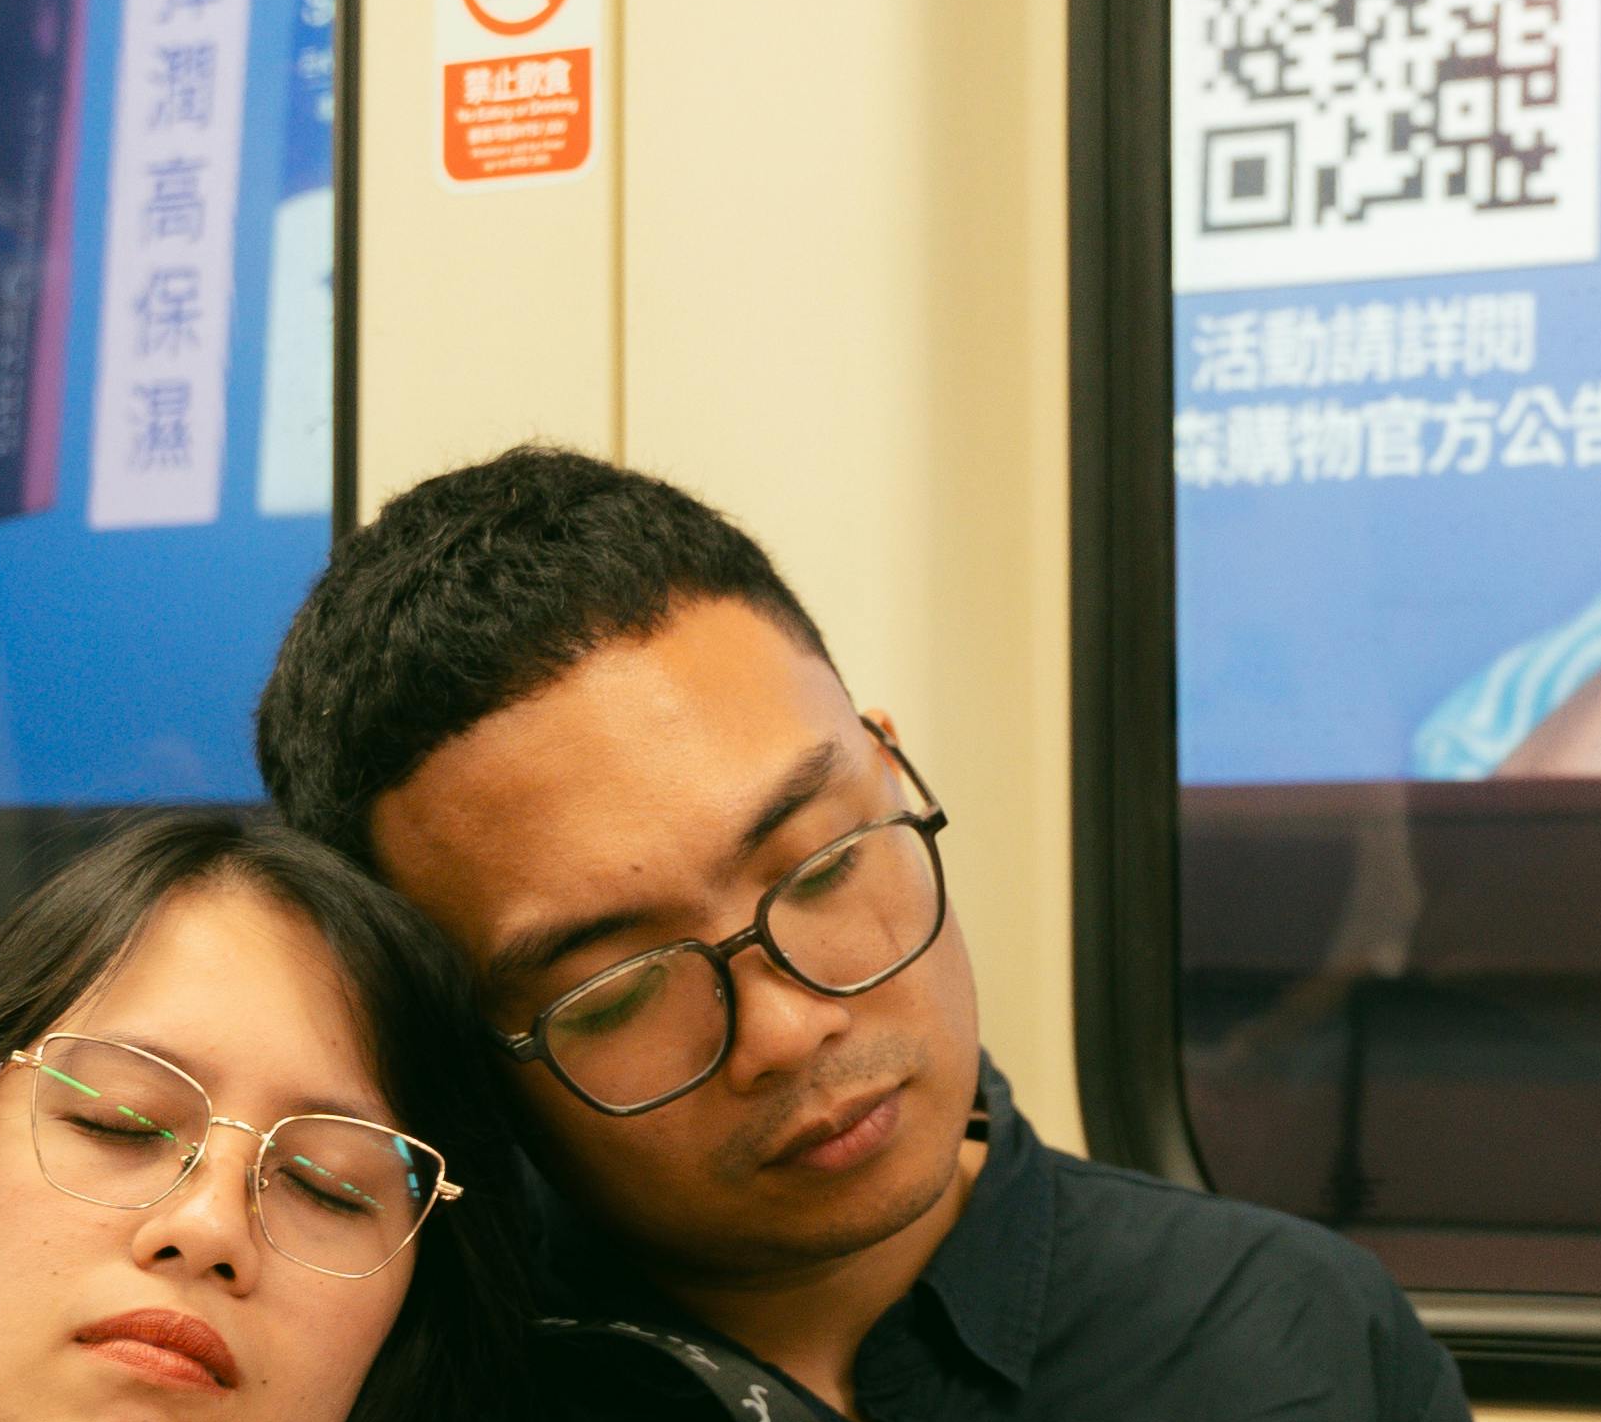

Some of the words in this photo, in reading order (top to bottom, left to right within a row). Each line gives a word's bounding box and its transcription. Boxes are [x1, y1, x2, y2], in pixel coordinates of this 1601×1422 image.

[1192, 293, 1536, 391] 活動請詳閱
